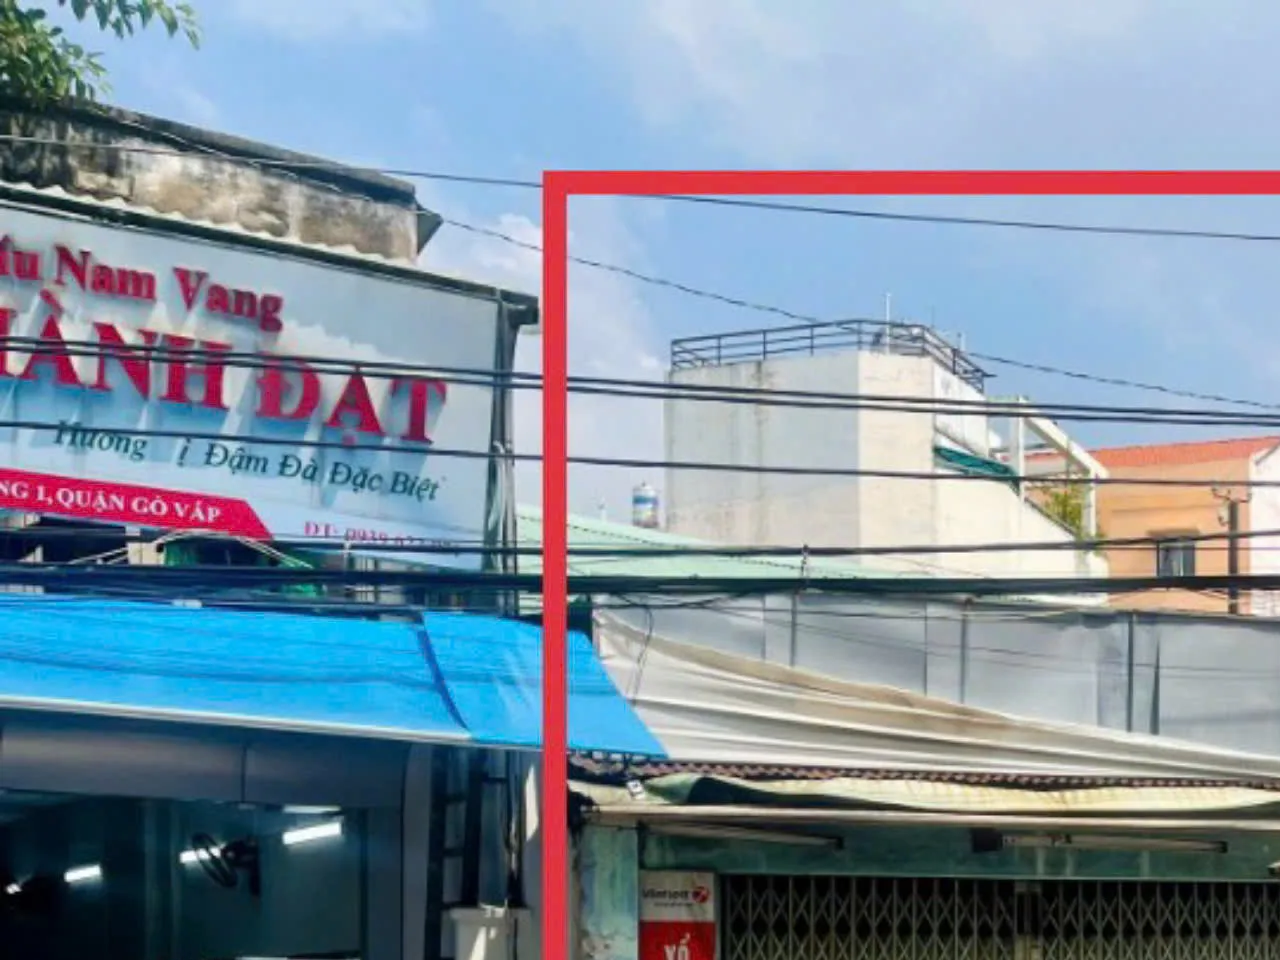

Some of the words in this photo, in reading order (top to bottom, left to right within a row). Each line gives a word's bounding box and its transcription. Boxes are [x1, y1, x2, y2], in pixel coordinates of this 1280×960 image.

[53, 243, 157, 302] Nam
[172, 266, 284, 333] Vang
[0, 288, 234, 410] ÀNH
[255, 352, 448, 446] ĐẠT
[203, 442, 268, 475] Đậm
[278, 453, 319, 481] Đà
[328, 461, 384, 493] Đặc
[390, 470, 441, 503] Biệt
